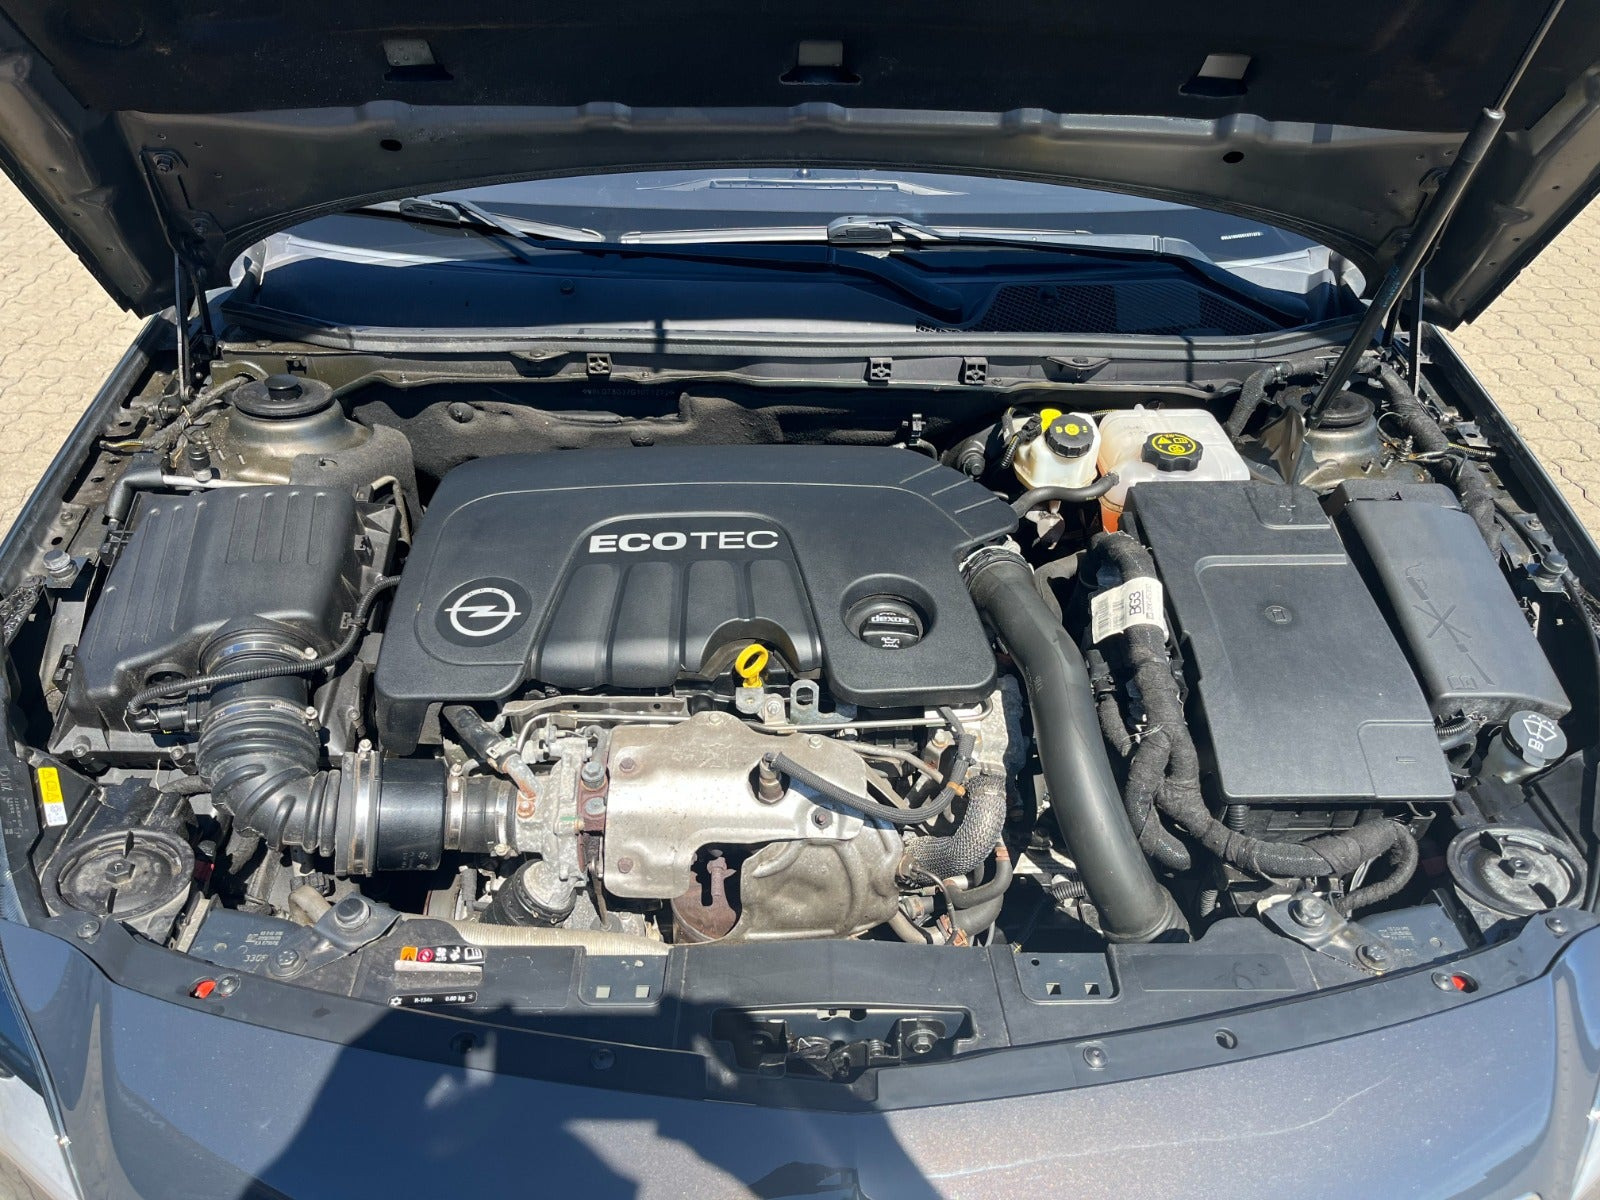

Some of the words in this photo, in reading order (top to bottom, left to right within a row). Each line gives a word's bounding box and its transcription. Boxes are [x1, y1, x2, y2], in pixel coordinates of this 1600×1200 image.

[588, 530, 779, 553] ECOTEC
[1129, 591, 1142, 615] BG3
[870, 614, 910, 623] dexos
